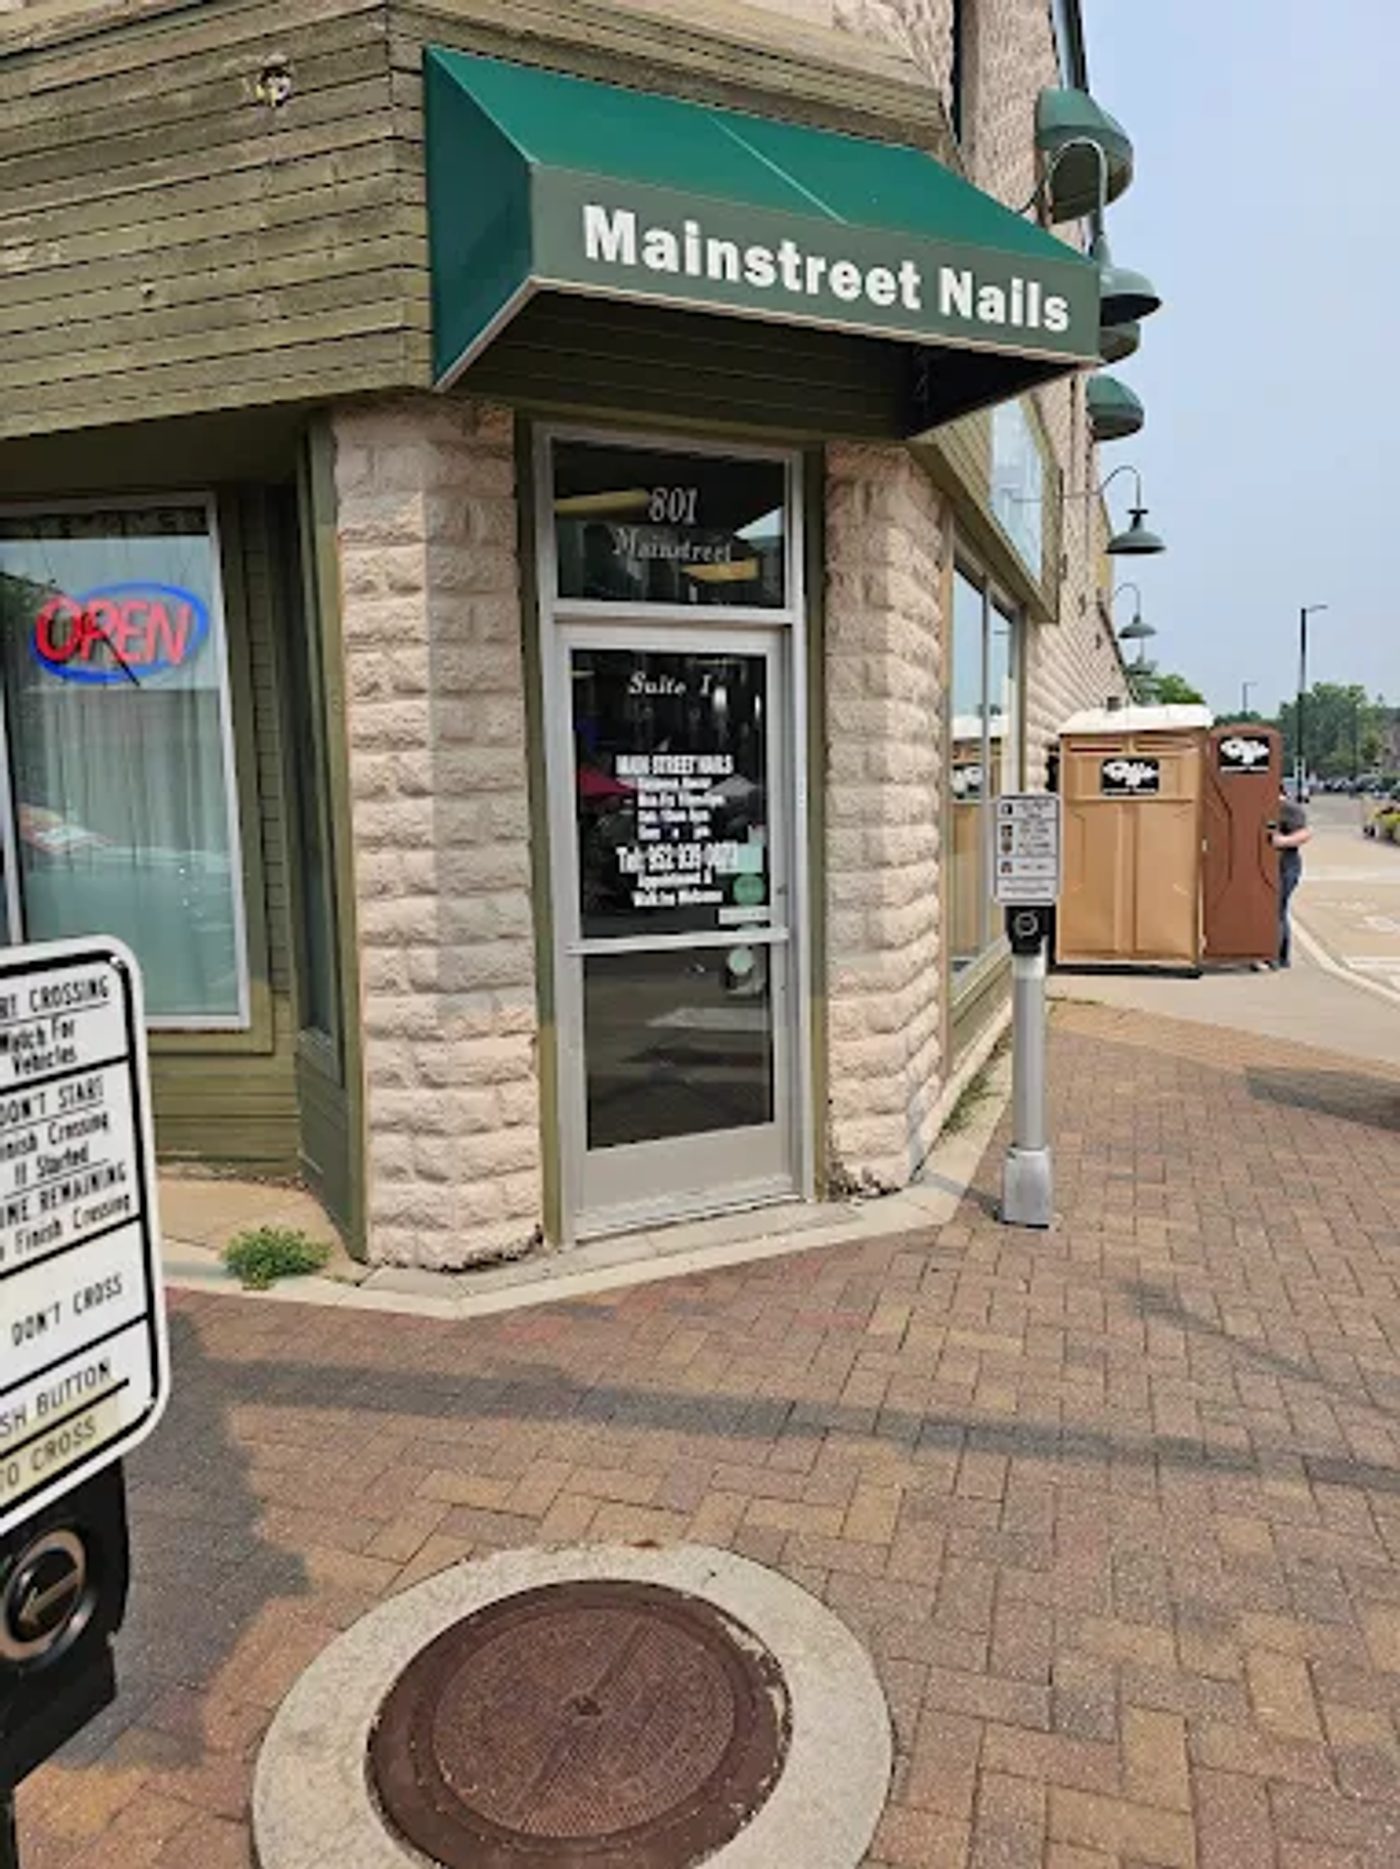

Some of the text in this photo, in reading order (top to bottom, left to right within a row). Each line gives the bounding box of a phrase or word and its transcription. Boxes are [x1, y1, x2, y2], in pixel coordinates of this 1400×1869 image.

[582, 204, 1070, 332] Mainstreet Nails
[649, 487, 698, 525] 801
[612, 527, 731, 563] Mainstreet
[35, 595, 192, 666] OPEN
[628, 671, 687, 697] Suite
[29, 975, 109, 1012] CROSSING
[51, 1015, 75, 1041] For
[12, 1045, 77, 1076] Vehicles
[58, 1076, 103, 1109] START
[48, 1111, 109, 1145] Crossing
[36, 1142, 89, 1178] Started
[40, 1162, 126, 1213] REMAINING
[15, 1194, 130, 1256] Finish Crossing
[11, 1273, 123, 1346] DON'T CROSS
[36, 1356, 111, 1417] BUTTON
[31, 1414, 96, 1472] CROSS
